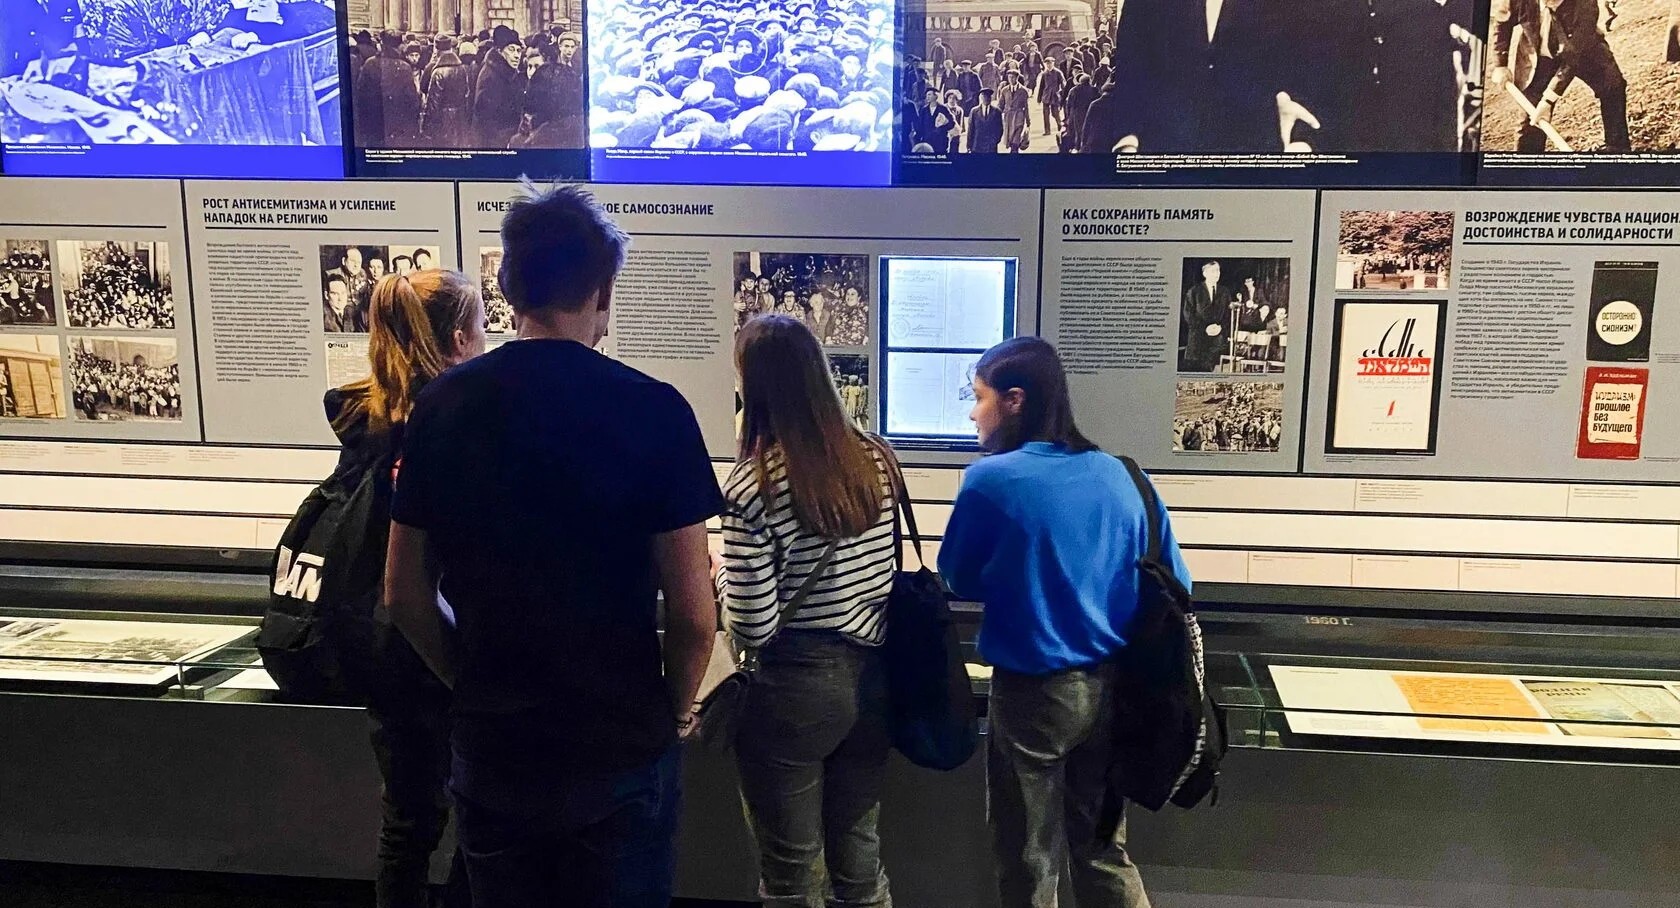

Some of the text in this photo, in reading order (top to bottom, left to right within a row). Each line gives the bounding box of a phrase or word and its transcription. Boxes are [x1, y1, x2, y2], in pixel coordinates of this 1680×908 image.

[202, 198, 396, 211] РОСТ АНТИСЕМИТИЗМА И УСИЛЕНИЕ
[602, 203, 620, 214] ОЕ
[623, 203, 714, 215] САМОСОЗНАНИЕ
[204, 213, 328, 225] НАПАДОК НА РЕЛИГИЮ
[1063, 208, 1214, 220] КАК СОХРАНИТЬ ПАМЯТЬ
[1465, 211, 1680, 225] ВОЗРОЖДЕНИЕ ЧУВСТВА НАЦИОН
[1062, 224, 1150, 235] О ХОЛОКОСТЕ?
[1463, 226, 1673, 240] ДОСТОИНСТВА И СОЛИДАРНОСТИ
